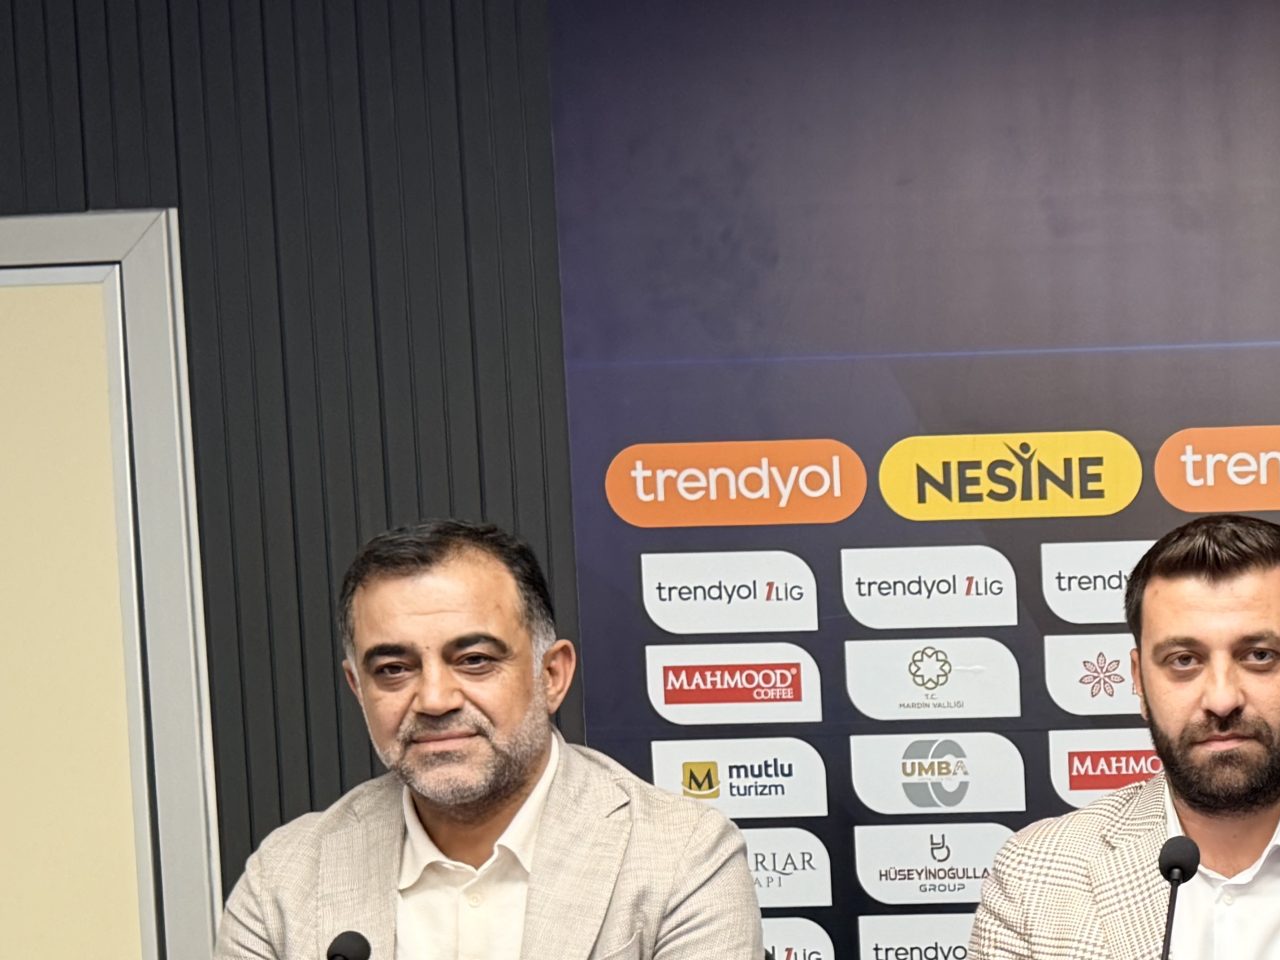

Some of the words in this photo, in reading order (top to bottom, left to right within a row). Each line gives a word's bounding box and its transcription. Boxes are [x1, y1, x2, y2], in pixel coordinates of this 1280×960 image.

[631, 456, 841, 507] trendyol
[855, 574, 957, 599] trendyol
[1055, 570, 1127, 591] trend
[656, 580, 757, 604] trendyol
[753, 688, 794, 700] COFFEE
[728, 757, 793, 778] mutlu
[1071, 755, 1164, 776] MAHMO
[729, 781, 785, 797] turizm
[754, 852, 817, 876] RLAR
[879, 866, 990, 881] HÜSEYİNOĞULLA
[754, 876, 783, 888] API
[919, 883, 966, 893] GROUP
